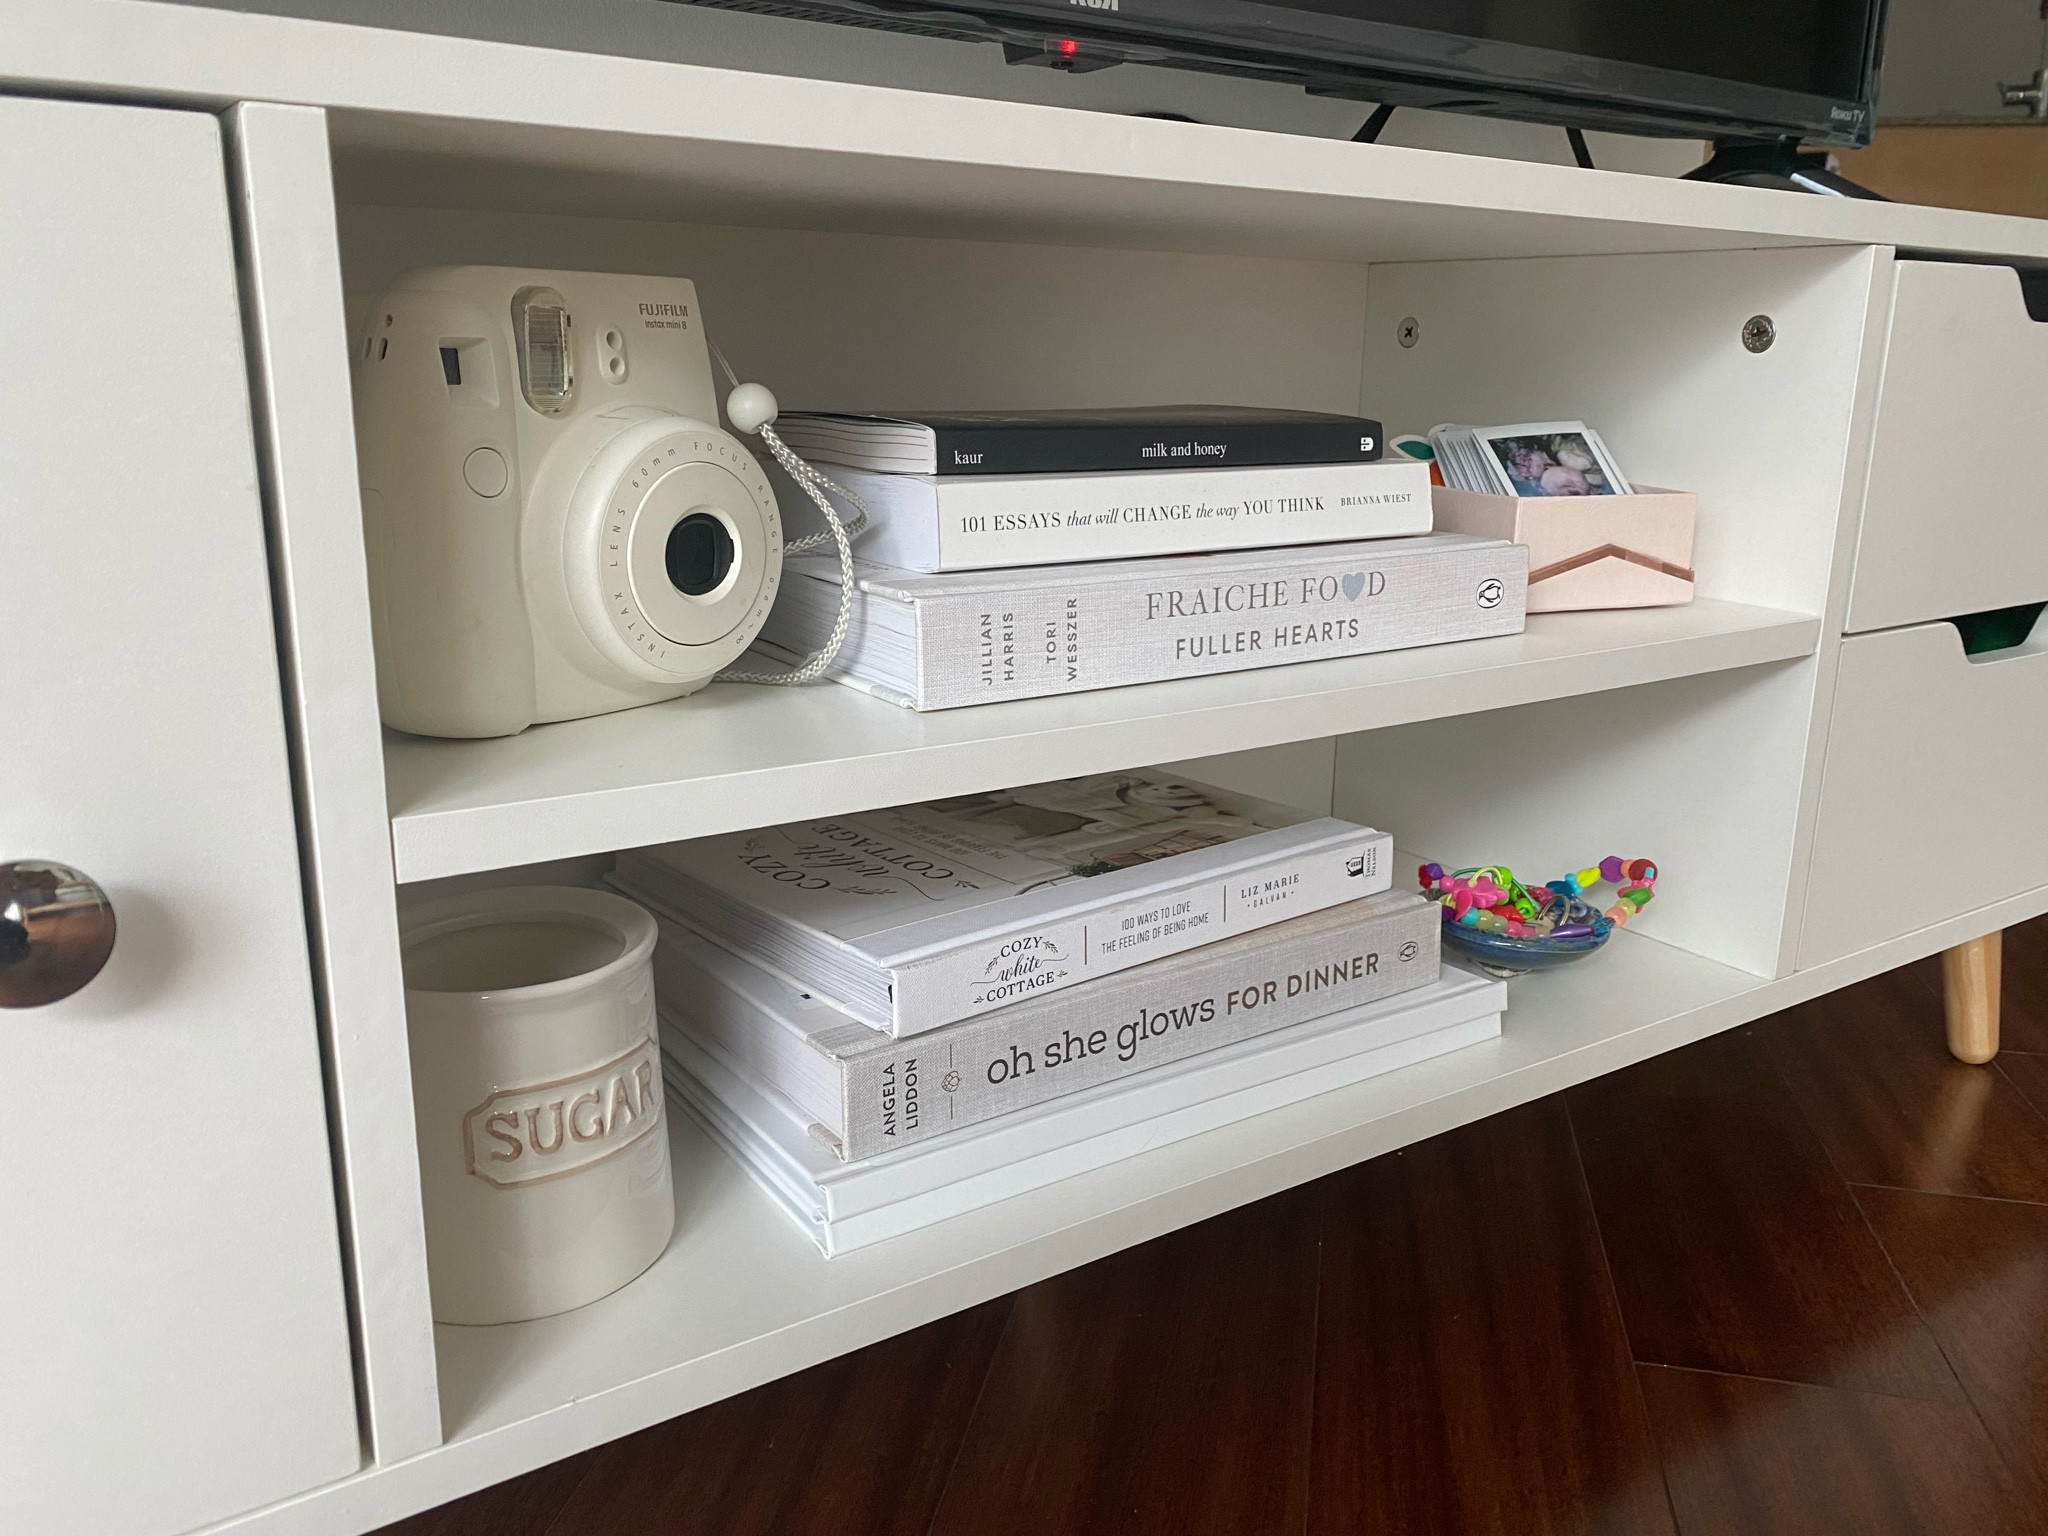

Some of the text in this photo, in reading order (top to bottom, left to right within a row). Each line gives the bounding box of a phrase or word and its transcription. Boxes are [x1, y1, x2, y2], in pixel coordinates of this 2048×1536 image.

[1853, 109, 1866, 122] TV
[638, 303, 688, 317] FUJIFILM
[645, 319, 688, 330] instax mini 8
[632, 448, 676, 489] 60mm
[694, 441, 748, 471] FOCUS
[954, 450, 984, 465] kaur
[1142, 441, 1227, 458] milk and honey
[758, 484, 778, 554] RANGE
[961, 496, 1325, 533] 101 ESSAYS that will CHANGE the way YOU THINK
[1340, 493, 1412, 507] BRIANNA WIEST
[610, 507, 626, 567] LENS
[1145, 580, 1289, 620] FRAICHE
[614, 591, 666, 658] INSTAX
[1046, 622, 1056, 664] TORI
[1067, 599, 1077, 681] WESSZER
[1176, 618, 1359, 659] FULLER HEARTS
[980, 614, 993, 685] JILLIAN
[1003, 613, 1014, 681] HARRIS
[811, 824, 954, 879] COTTAGE
[738, 854, 830, 890] COZY
[1241, 873, 1300, 899] LIZ MARIE
[1121, 901, 1191, 931] 100 WAYS TO LOVE
[1253, 891, 1287, 908] GALVAN
[1000, 936, 1043, 958] COZY
[1101, 912, 1209, 955] THE FEELING OF BEING HOME
[986, 971, 1054, 1002] COTTAGE
[987, 953, 1379, 1084] oh she glows FOR DINNER
[485, 1060, 655, 1162] SUGAR
[882, 1063, 896, 1136] ANGELA
[905, 1059, 918, 1130] LIDDON
